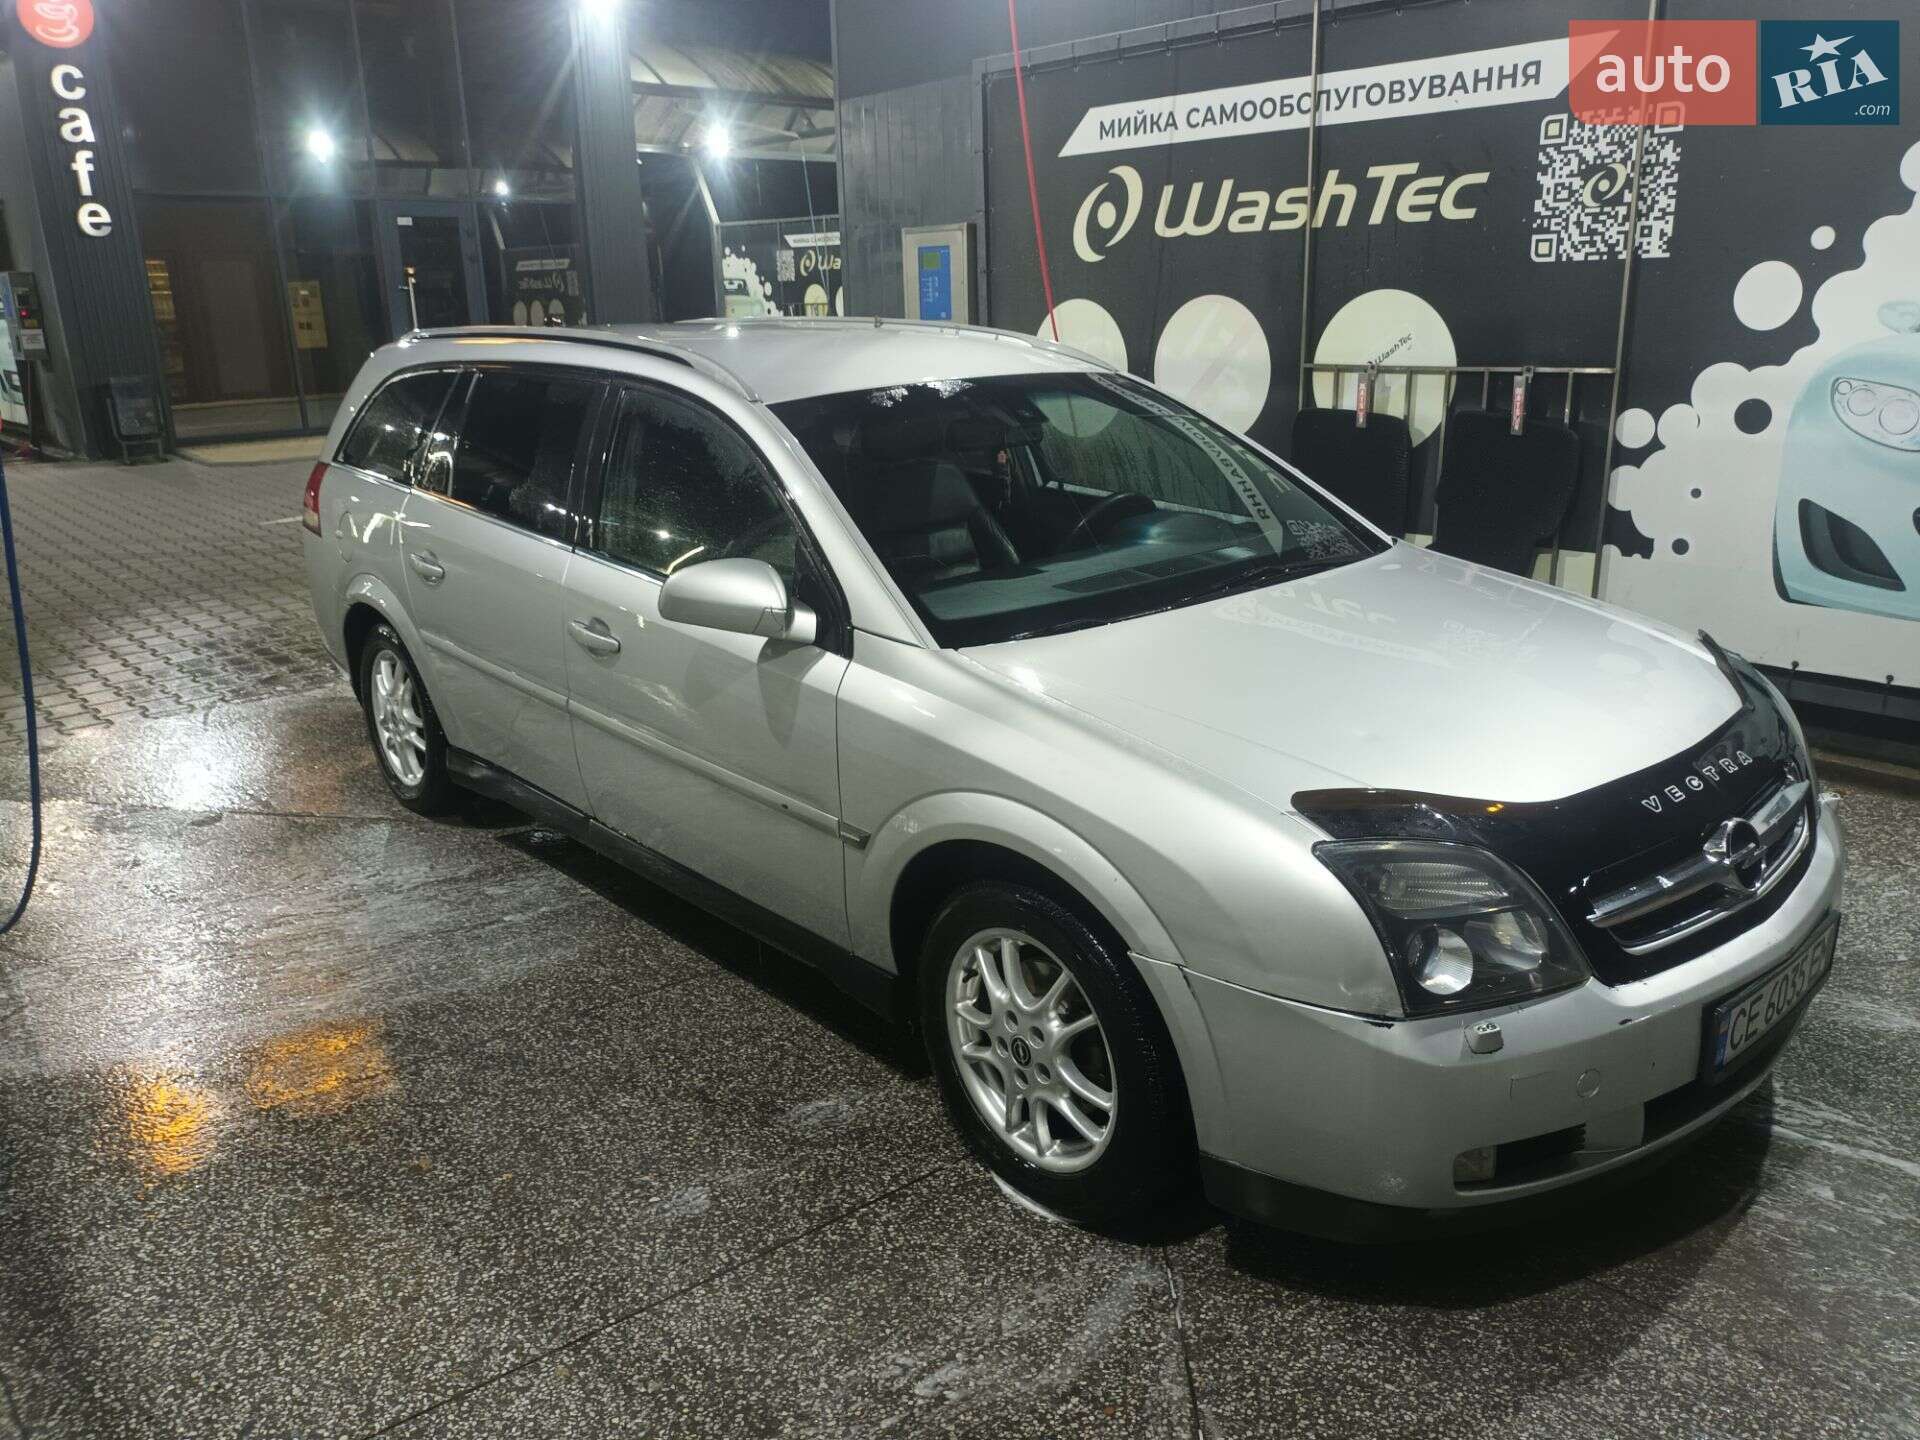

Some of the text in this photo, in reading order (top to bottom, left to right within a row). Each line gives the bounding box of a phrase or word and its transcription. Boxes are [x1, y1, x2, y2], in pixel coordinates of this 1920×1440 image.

[1099, 59, 1543, 140] МИЙКА САМООБСЛУГОВУВАННЯ
[51, 64, 112, 237] cafe
[1641, 750, 1753, 813] VECTRA
[1730, 994, 1764, 1051] CE
